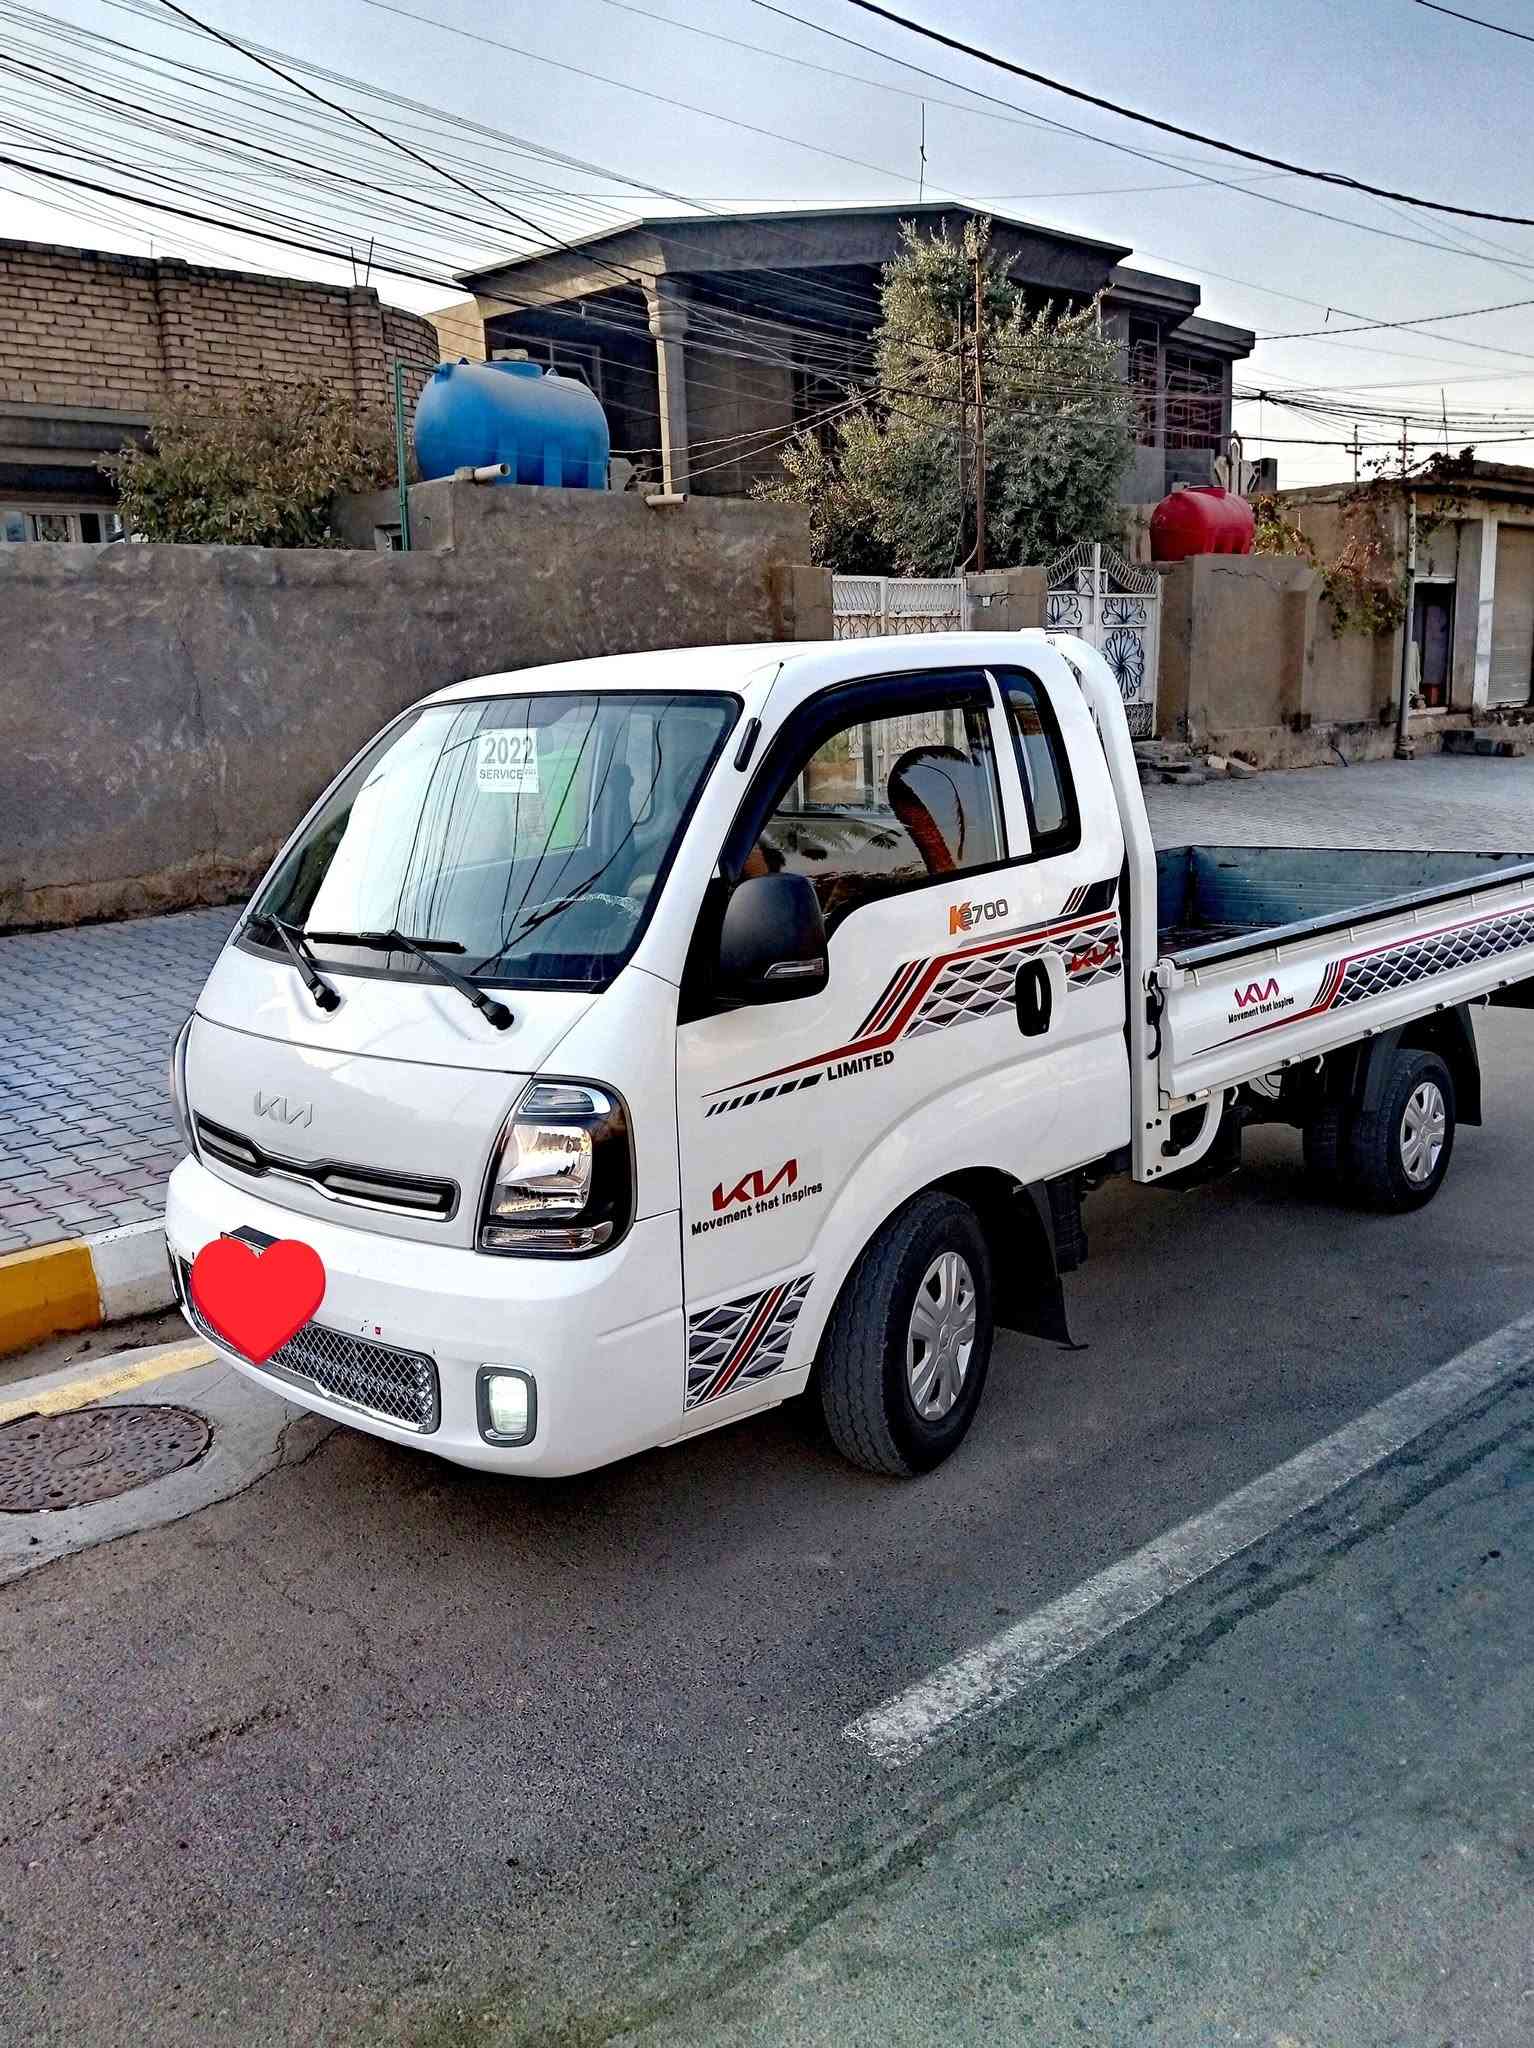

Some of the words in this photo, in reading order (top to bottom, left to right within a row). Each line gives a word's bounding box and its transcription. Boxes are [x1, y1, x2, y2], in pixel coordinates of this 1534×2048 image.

[482, 736, 534, 764] 2022
[479, 768, 523, 780] SERVICE
[1234, 978, 1279, 1007] KIA
[1228, 1006, 1259, 1023] Movement
[1260, 1002, 1272, 1013] that
[827, 1050, 895, 1081] LIMITED
[254, 1088, 313, 1129] KIA
[711, 1158, 798, 1212] KIA
[691, 1205, 753, 1236] Movement
[754, 1194, 780, 1214] that
